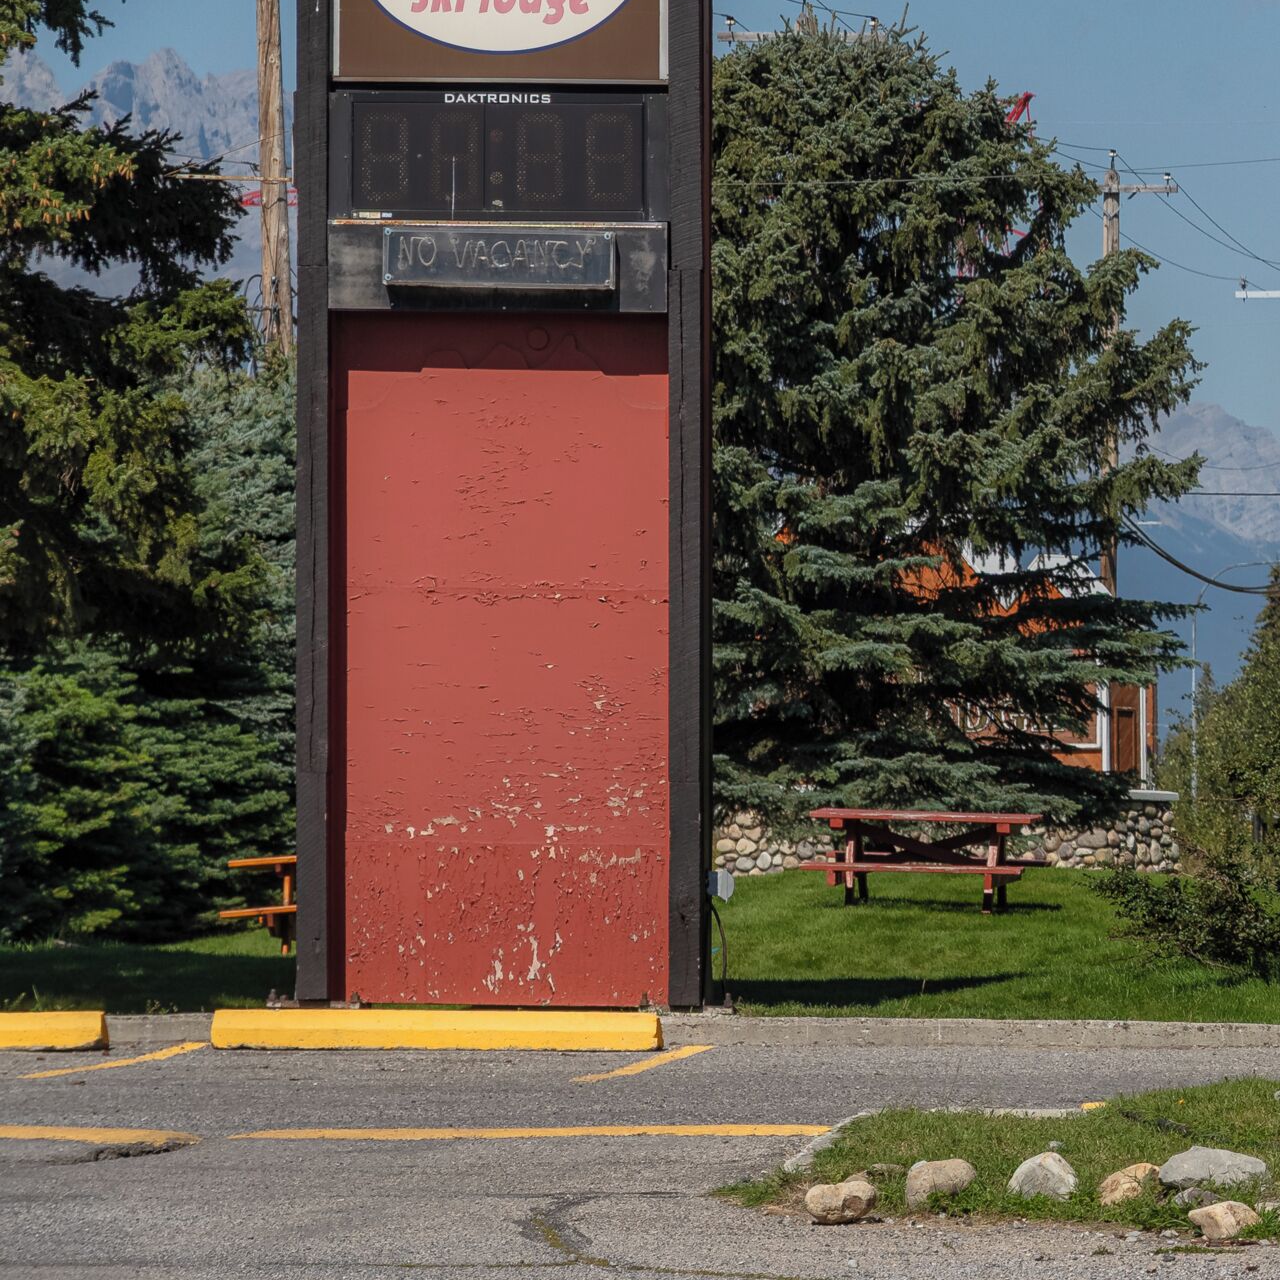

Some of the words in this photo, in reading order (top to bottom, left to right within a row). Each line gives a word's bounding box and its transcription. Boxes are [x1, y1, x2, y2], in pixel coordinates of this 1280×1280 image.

[444, 92, 552, 105] DAKTRONICS
[398, 236, 438, 269] NO
[450, 236, 597, 269] VACANCY
